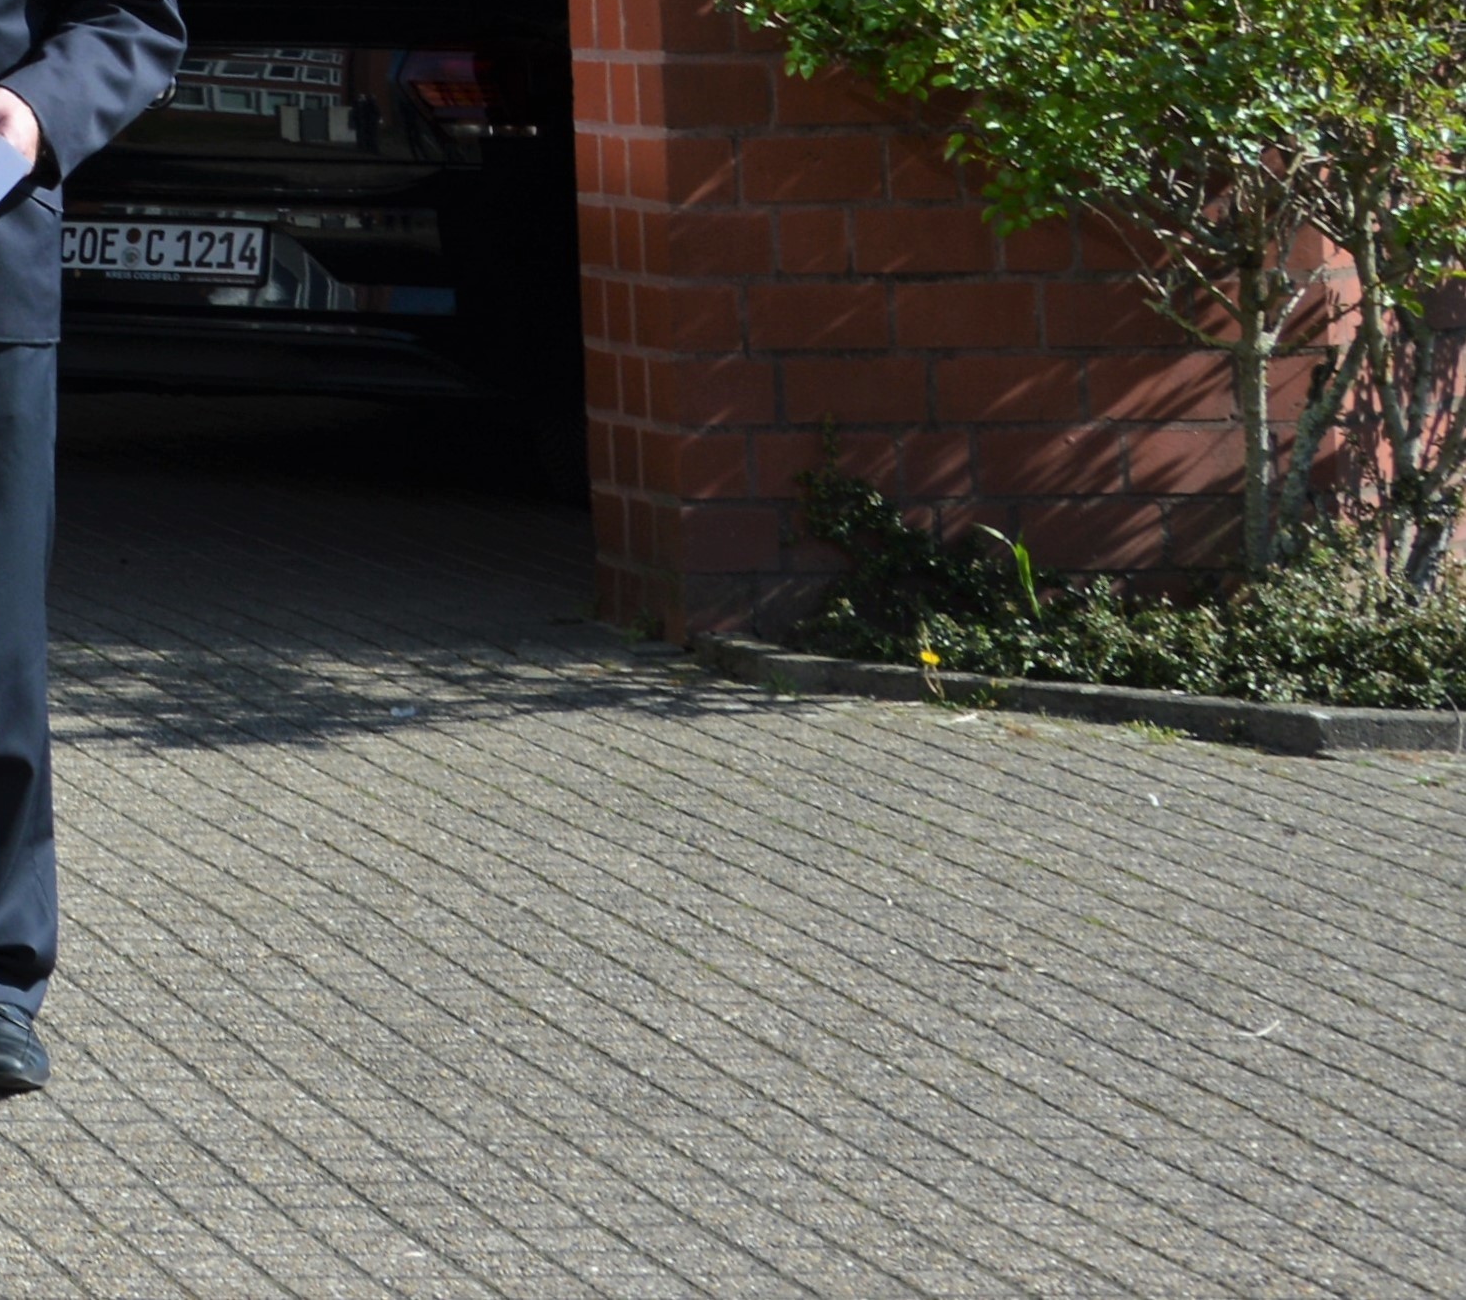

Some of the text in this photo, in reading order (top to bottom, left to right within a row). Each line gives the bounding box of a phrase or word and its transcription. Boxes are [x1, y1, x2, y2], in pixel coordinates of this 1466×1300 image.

[61, 227, 258, 270] COE C 1214
